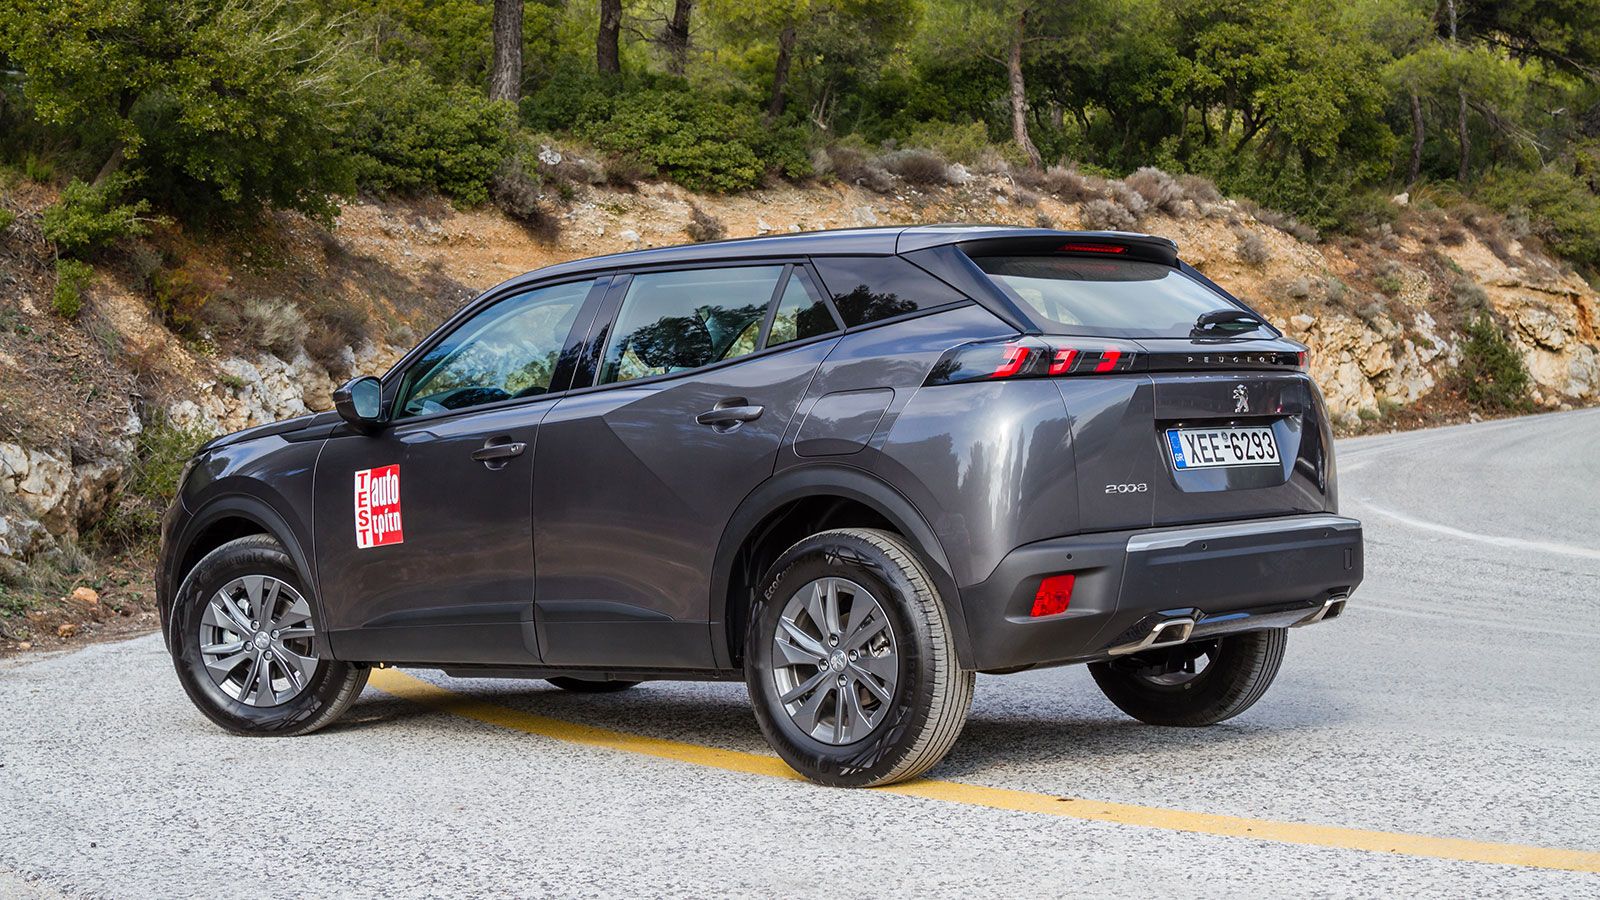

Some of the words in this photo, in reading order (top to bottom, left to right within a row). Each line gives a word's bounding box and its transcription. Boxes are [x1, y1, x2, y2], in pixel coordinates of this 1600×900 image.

[1174, 453, 1185, 462] GR
[371, 468, 399, 508] auto
[1105, 483, 1148, 494] 2008
[357, 472, 370, 545] TEST
